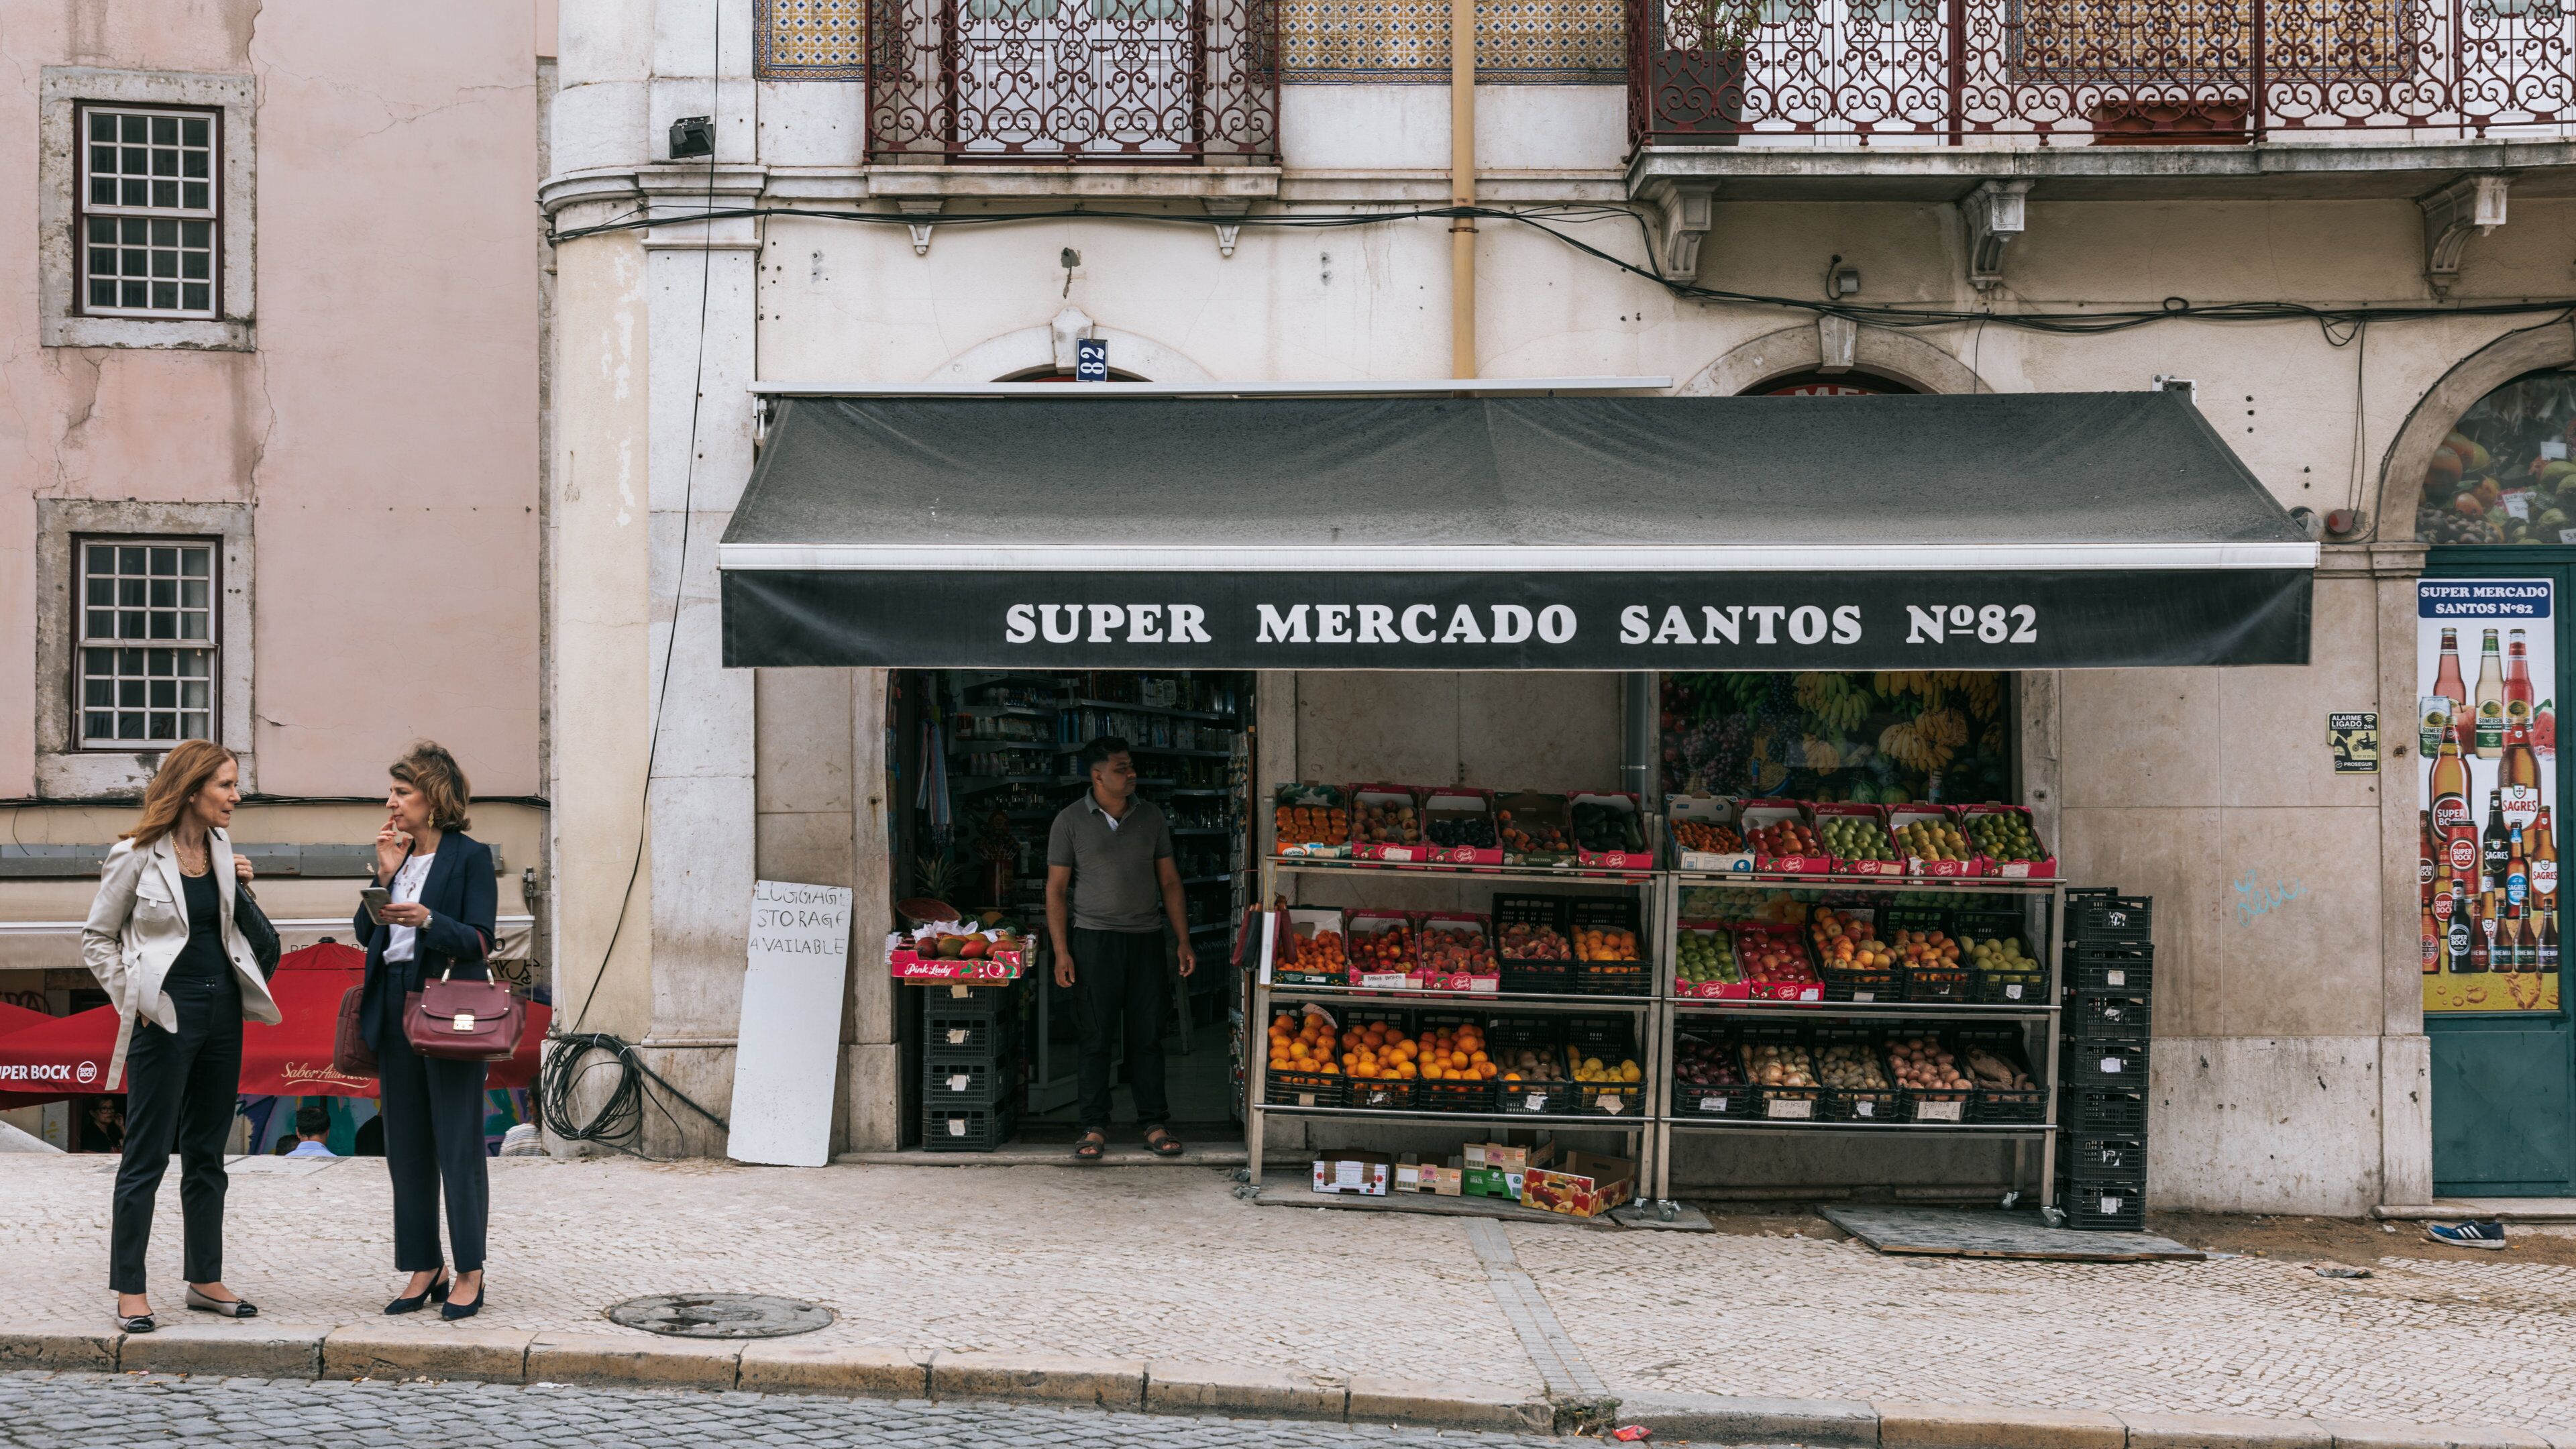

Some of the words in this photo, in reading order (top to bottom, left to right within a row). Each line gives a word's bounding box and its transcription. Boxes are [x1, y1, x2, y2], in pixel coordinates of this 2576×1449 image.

[1080, 347, 1105, 374] 82
[2420, 587, 2470, 597] SUPER
[2473, 587, 2548, 597] MERCADO
[2435, 603, 2497, 614] SANTOS
[1006, 604, 1212, 643] SUPER
[1256, 604, 1577, 644] MERCADO
[1619, 604, 1862, 645] SANTOS
[2502, 800, 2536, 812] SAGRES
[2437, 809, 2465, 818] SUPER
[2485, 851, 2509, 859] SAGRES
[2533, 871, 2557, 880] SAGRES
[757, 909, 846, 928] STORAGE
[749, 937, 845, 955] AVAILABLE
[905, 963, 929, 975] Pink
[929, 964, 952, 976] Lady
[0, 1065, 28, 1079] PER
[31, 1065, 71, 1079] BOCK
[281, 1061, 319, 1079] Sabor
